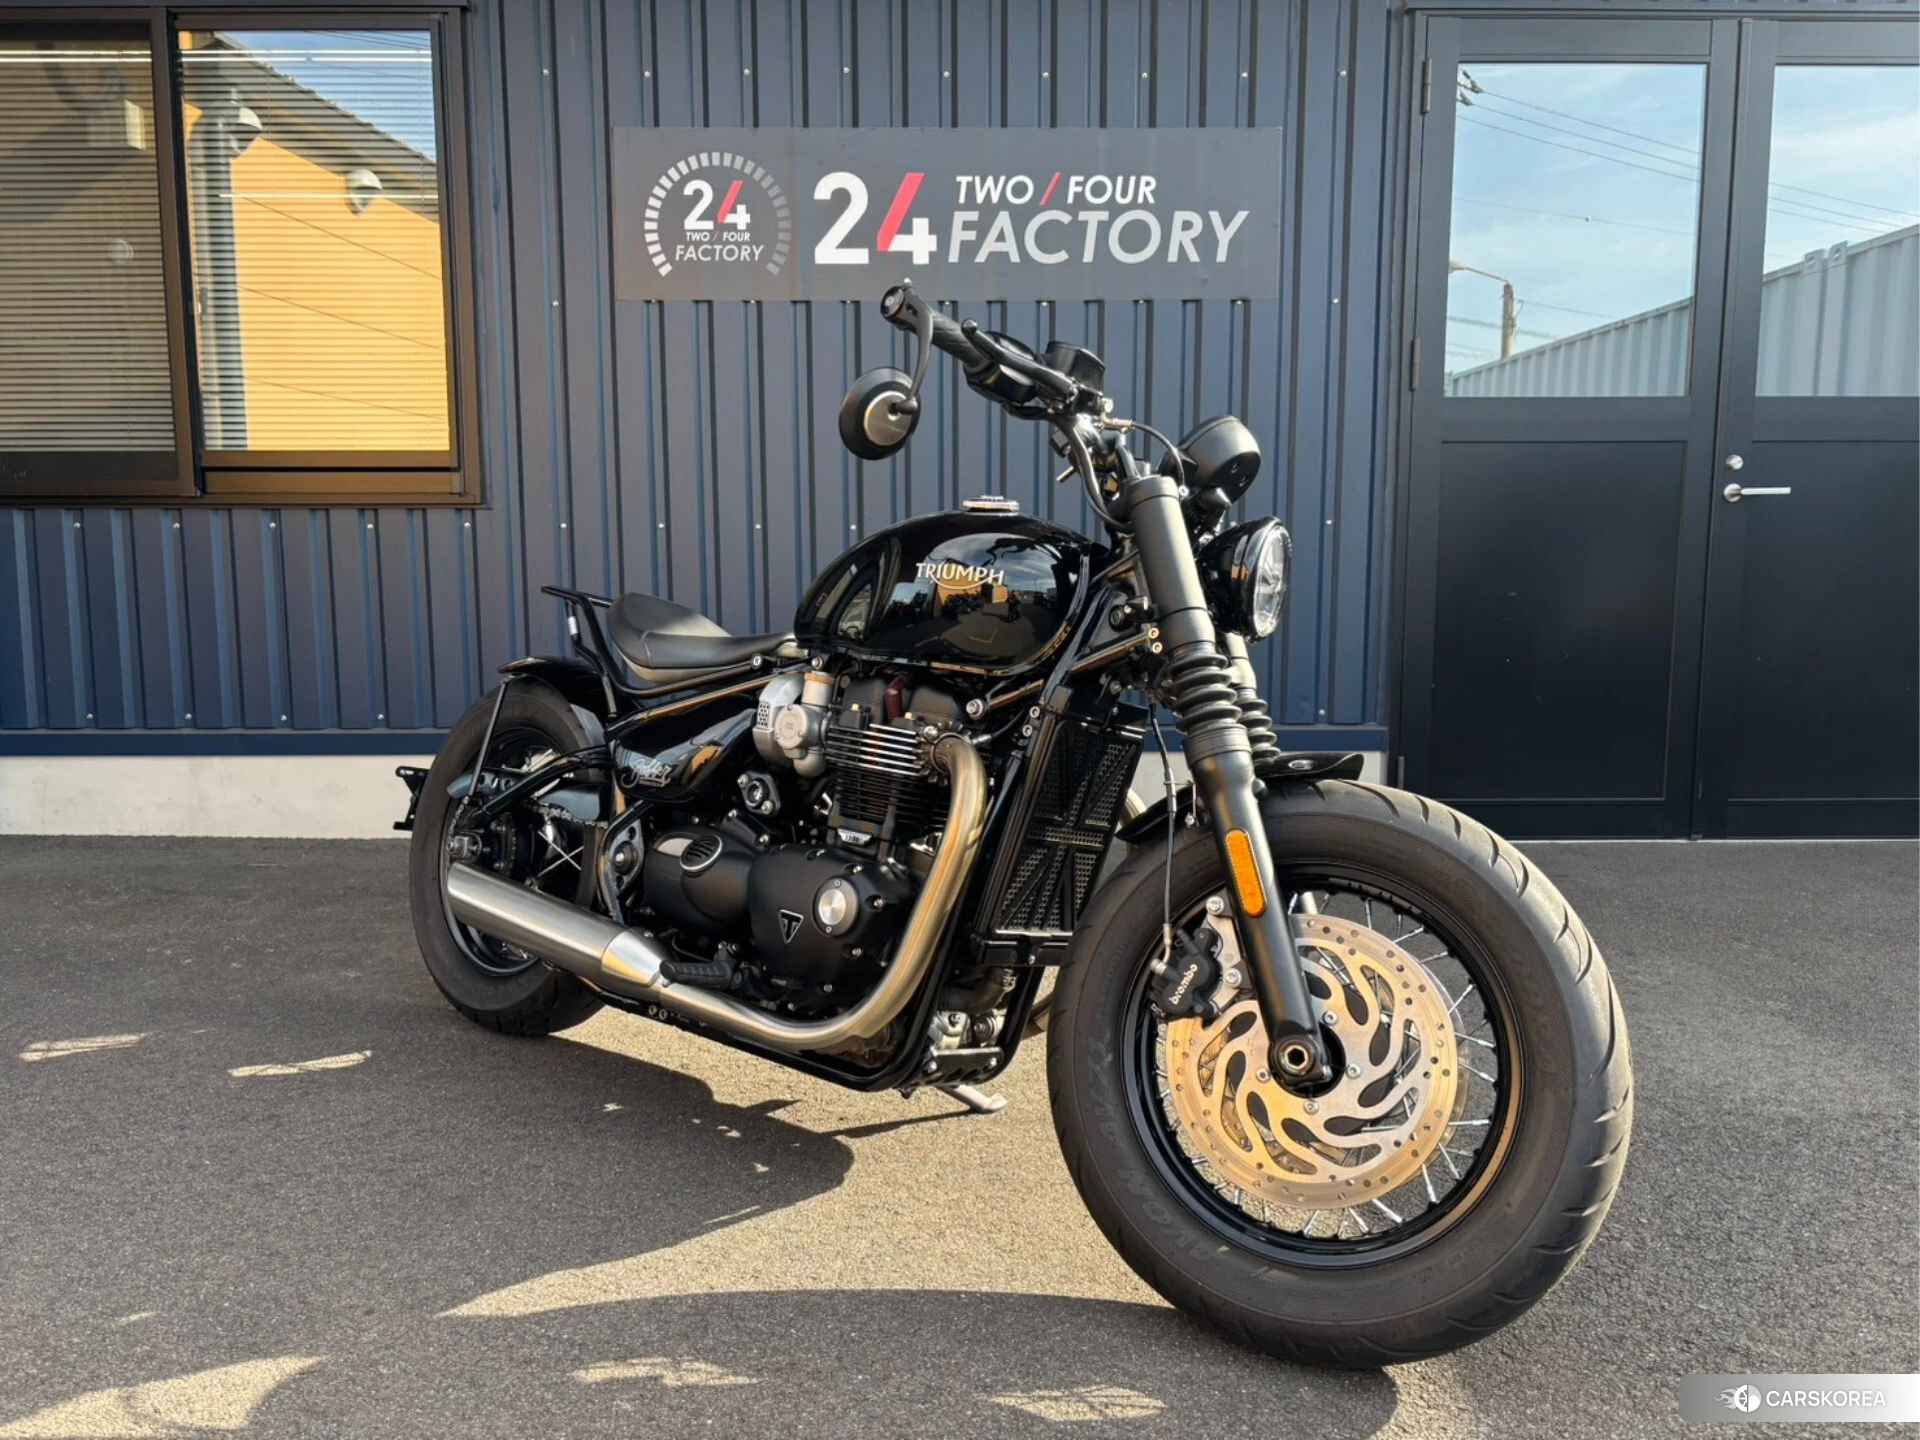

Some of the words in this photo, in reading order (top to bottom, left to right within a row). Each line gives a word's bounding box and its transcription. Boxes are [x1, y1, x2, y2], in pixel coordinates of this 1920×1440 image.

[683, 179, 751, 230] 24
[813, 172, 938, 265] 24
[675, 245, 765, 261] FACTORY
[948, 210, 1250, 265] FACTORY
[915, 562, 1005, 587] TRIUMPH
[1168, 963, 1198, 1005] brembo
